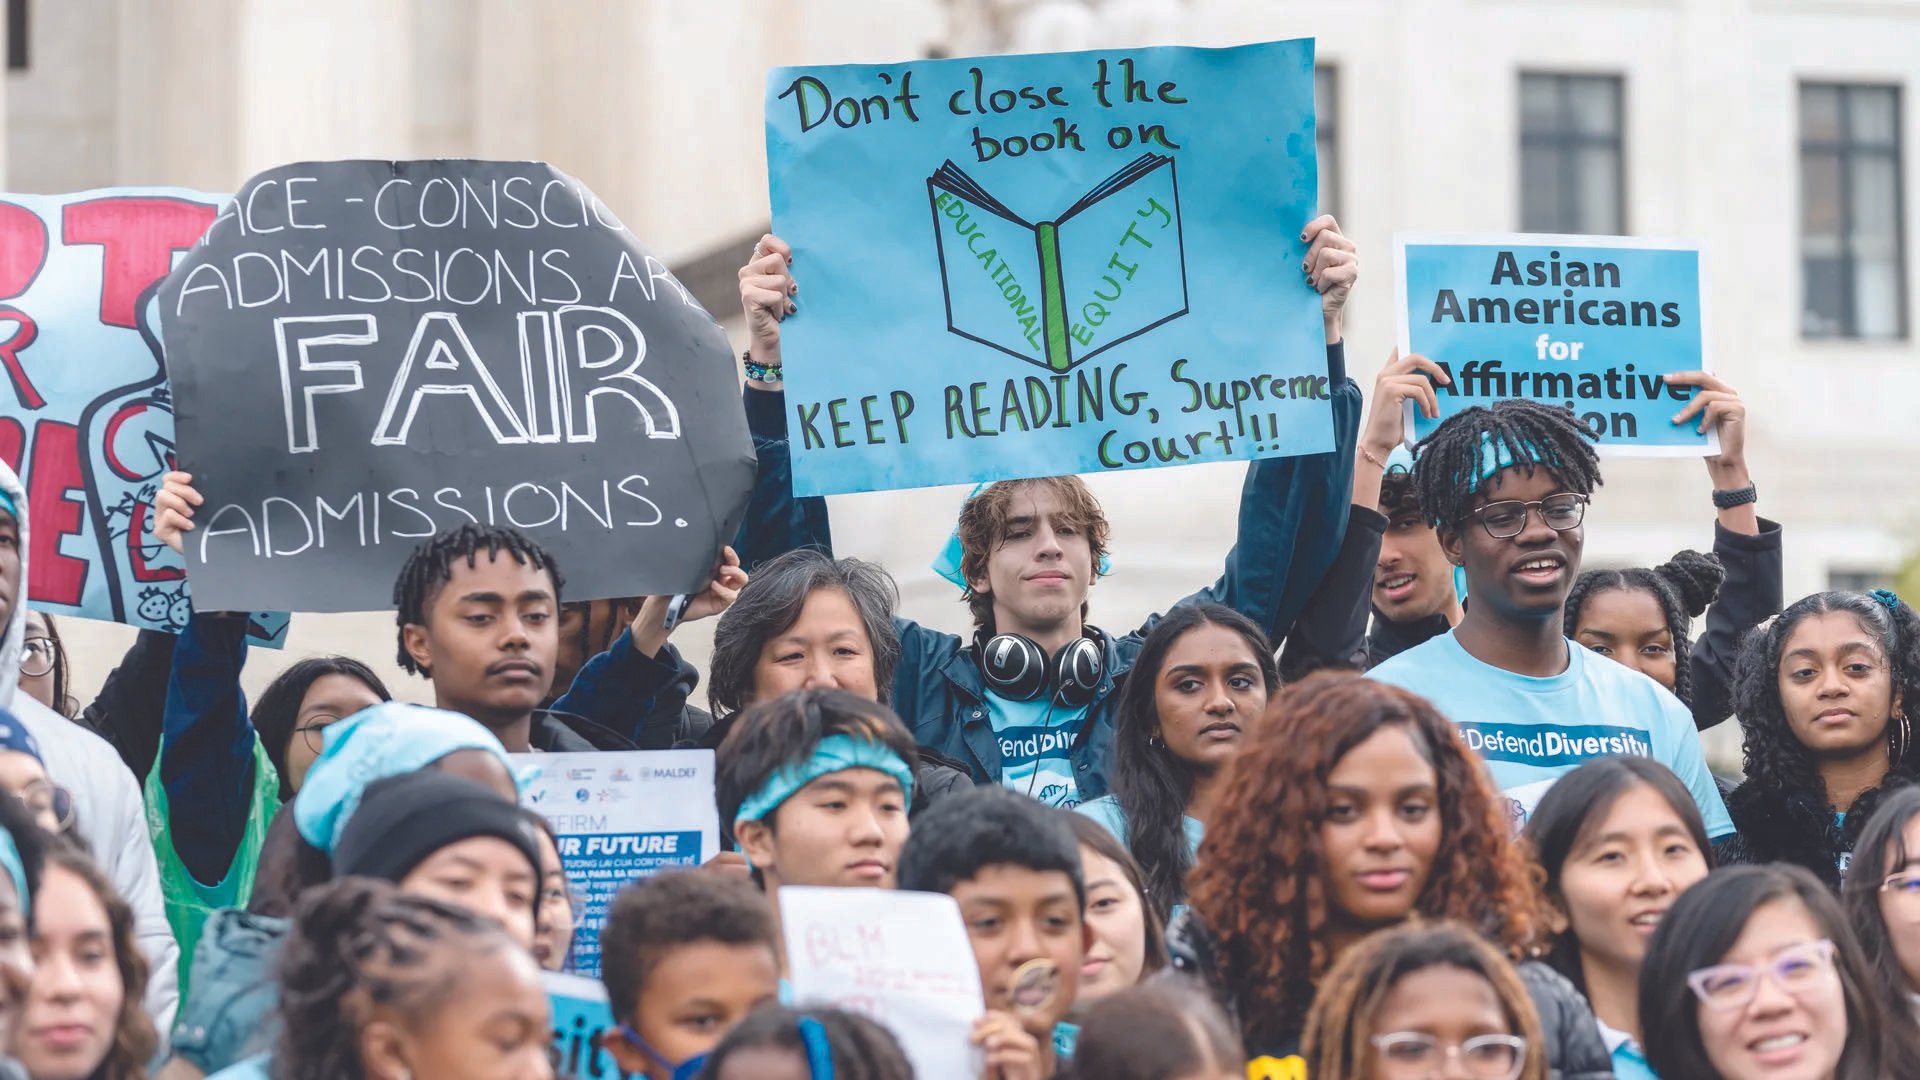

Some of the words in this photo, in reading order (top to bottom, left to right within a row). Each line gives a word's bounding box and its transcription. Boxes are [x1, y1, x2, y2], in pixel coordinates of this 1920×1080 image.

[777, 70, 921, 133] Don't
[948, 66, 1069, 115] close
[1093, 57, 1188, 104] the
[972, 117, 1086, 162] book
[1106, 120, 1181, 151] on
[201, 177, 328, 247] ACE
[176, 244, 582, 317] ADMISSIONS
[934, 190, 1041, 353] EDUCATIONAL
[1071, 195, 1173, 347] EQUITY
[1490, 250, 1621, 289] Asian
[1431, 288, 1681, 329] Americans
[273, 303, 680, 454] FAIR
[1536, 333, 1584, 361] for
[797, 390, 915, 451] KEEP
[945, 362, 1160, 440] READING,
[1171, 359, 1332, 437] Supreme
[1430, 360, 1692, 402] Affirmative
[1098, 411, 1279, 469] Court!!
[200, 474, 688, 564] ADMISSIONS.
[654, 767, 697, 779] MALDEF
[586, 835, 679, 856] FUTURE
